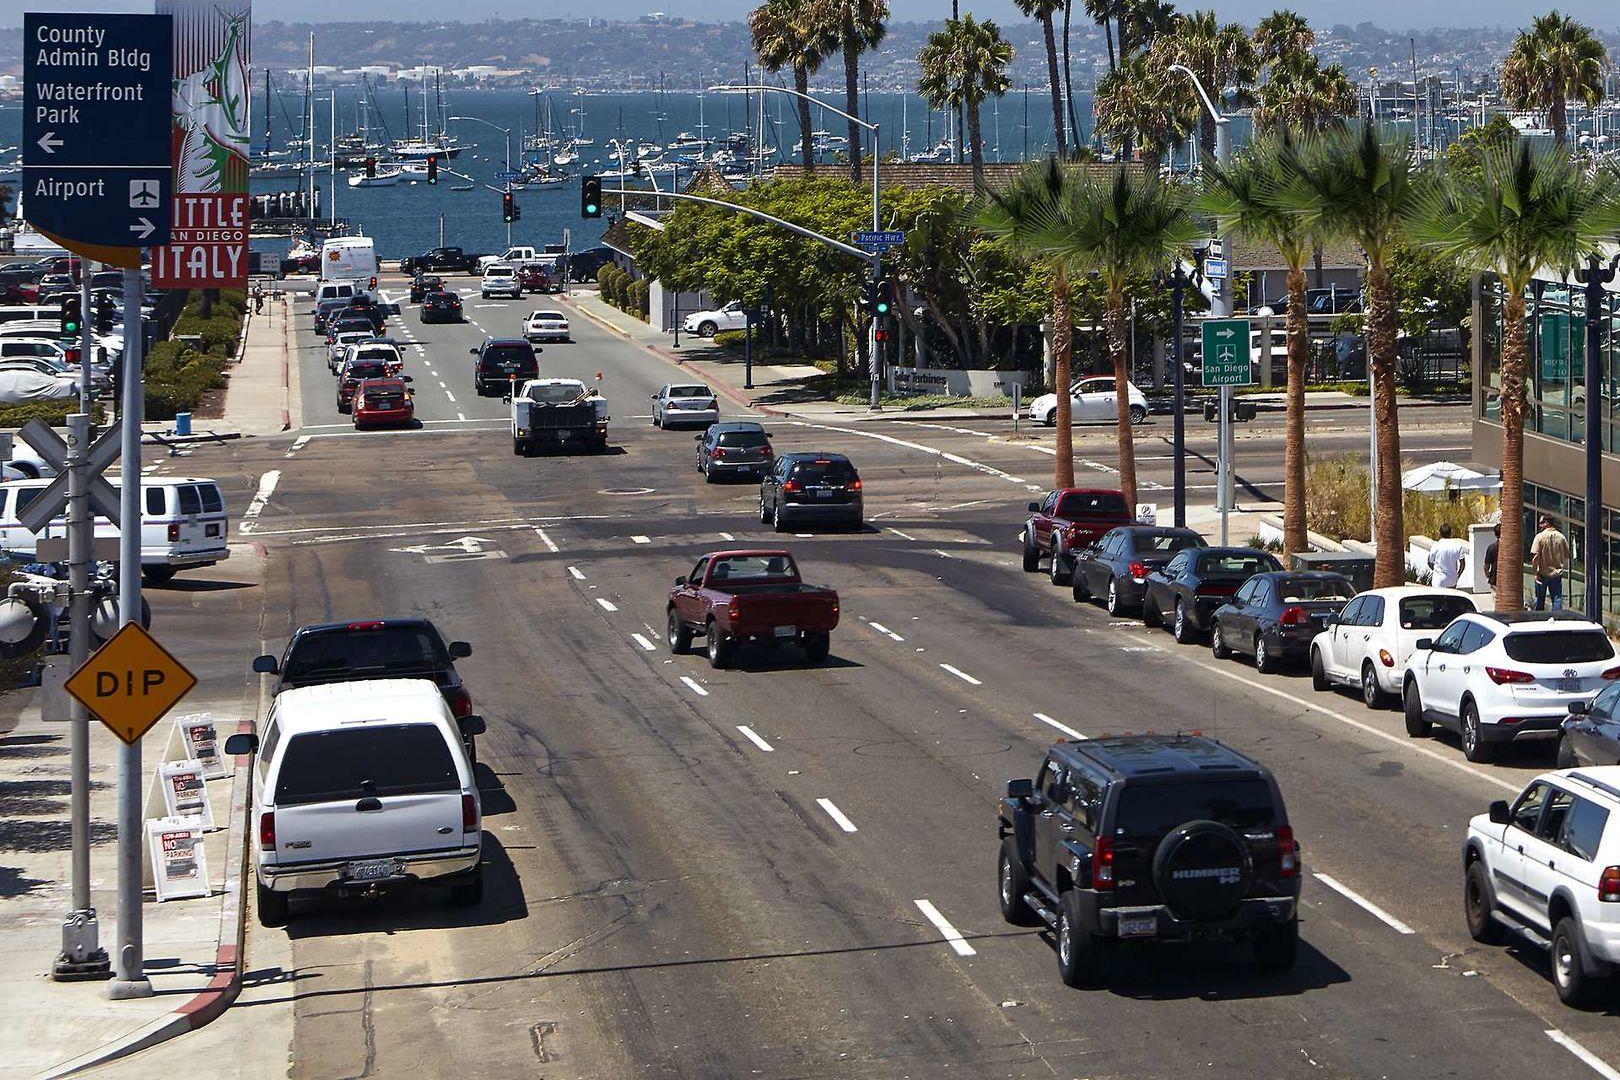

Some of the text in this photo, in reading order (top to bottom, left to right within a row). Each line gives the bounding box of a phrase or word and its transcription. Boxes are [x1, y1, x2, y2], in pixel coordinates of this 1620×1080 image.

[36, 25, 106, 47] County
[36, 48, 151, 71] Admin Bldg
[36, 82, 144, 101] Waterfront
[36, 106, 80, 124] Park
[35, 178, 105, 200] Airport
[174, 197, 244, 227] ITTLE
[170, 231, 244, 241] AN DIEGO
[158, 245, 243, 279] ITALY
[1224, 365, 1249, 373] Diego
[1211, 375, 1242, 384] Airport
[96, 669, 166, 698] DIP
[164, 840, 176, 850] NO
[165, 850, 192, 858] PARKING
[1172, 867, 1240, 879] HUMMER
